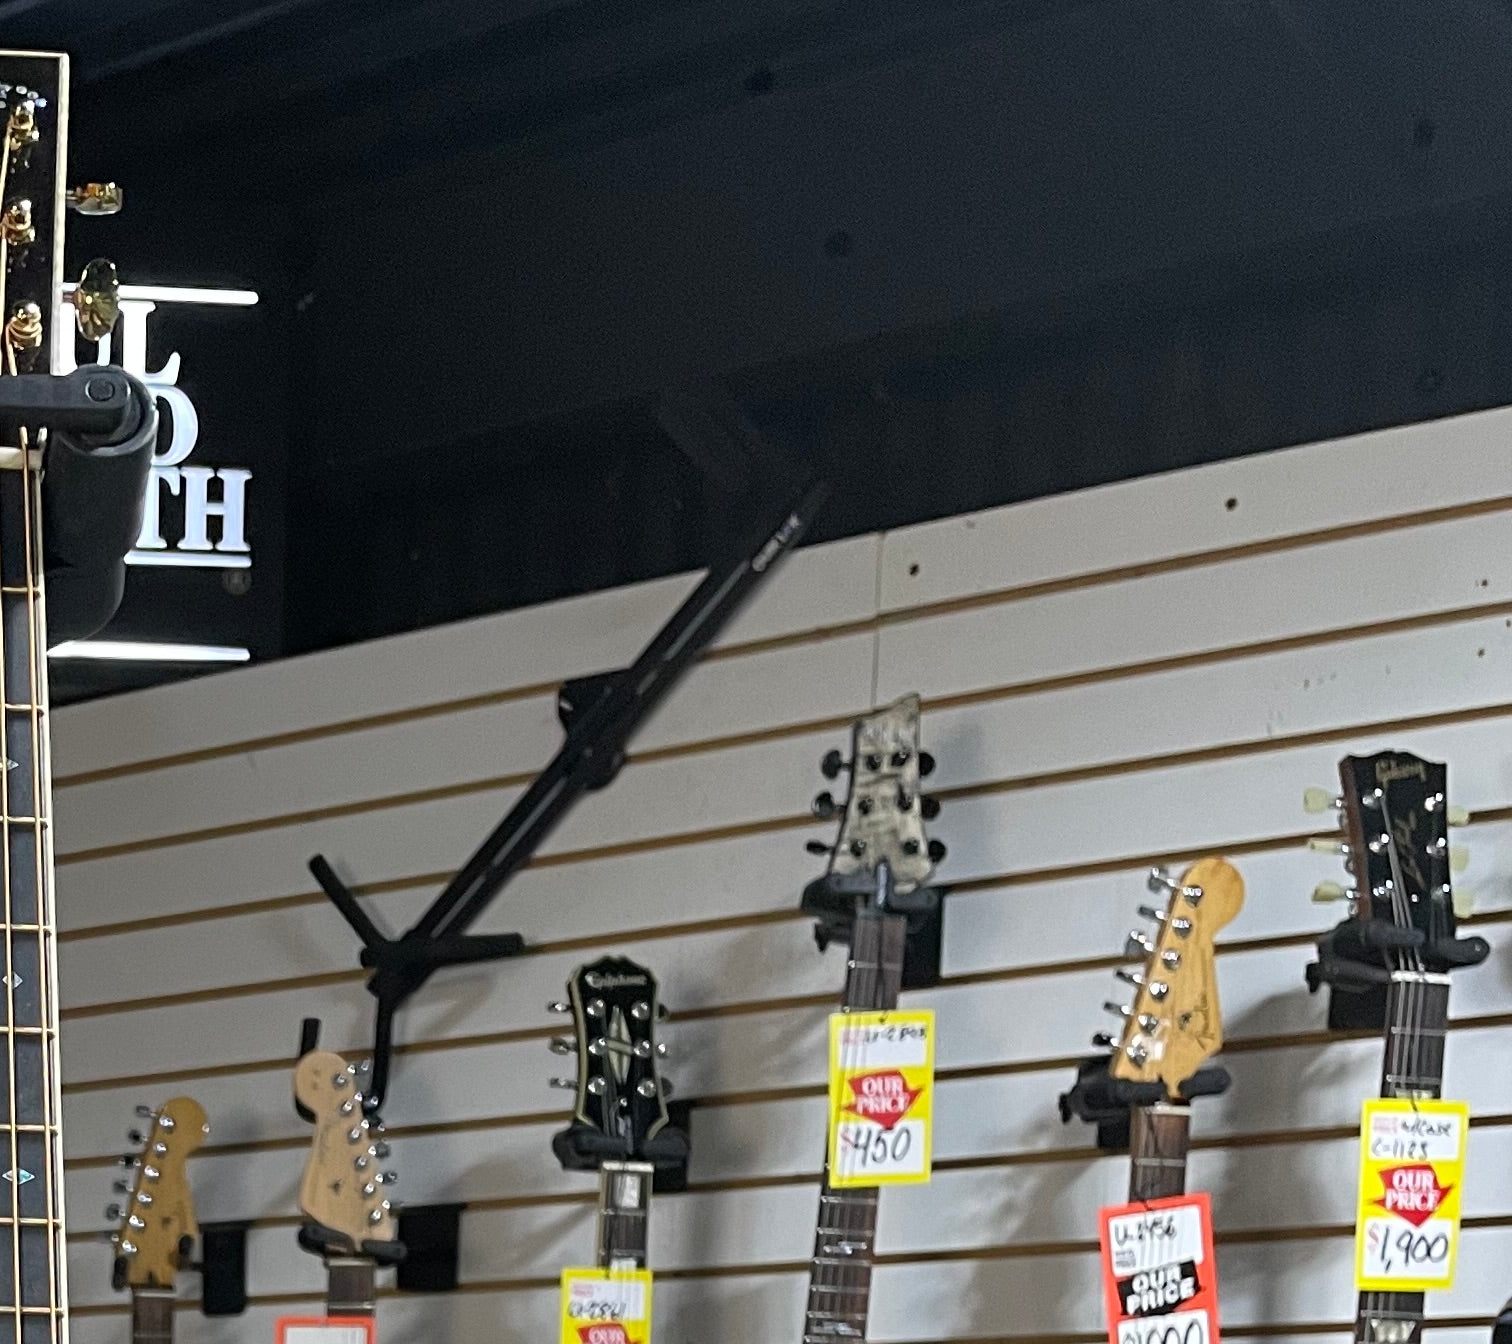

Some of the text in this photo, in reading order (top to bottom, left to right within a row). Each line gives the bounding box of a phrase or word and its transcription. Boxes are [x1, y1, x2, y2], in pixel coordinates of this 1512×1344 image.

[861, 1076, 904, 1097] OUR
[856, 1095, 910, 1114] PRICE
[1392, 1169, 1436, 1192] OUR
[1385, 1189, 1442, 1212] PRICE
[1131, 1264, 1182, 1294] OUR
[1126, 1276, 1196, 1317] PRICE
